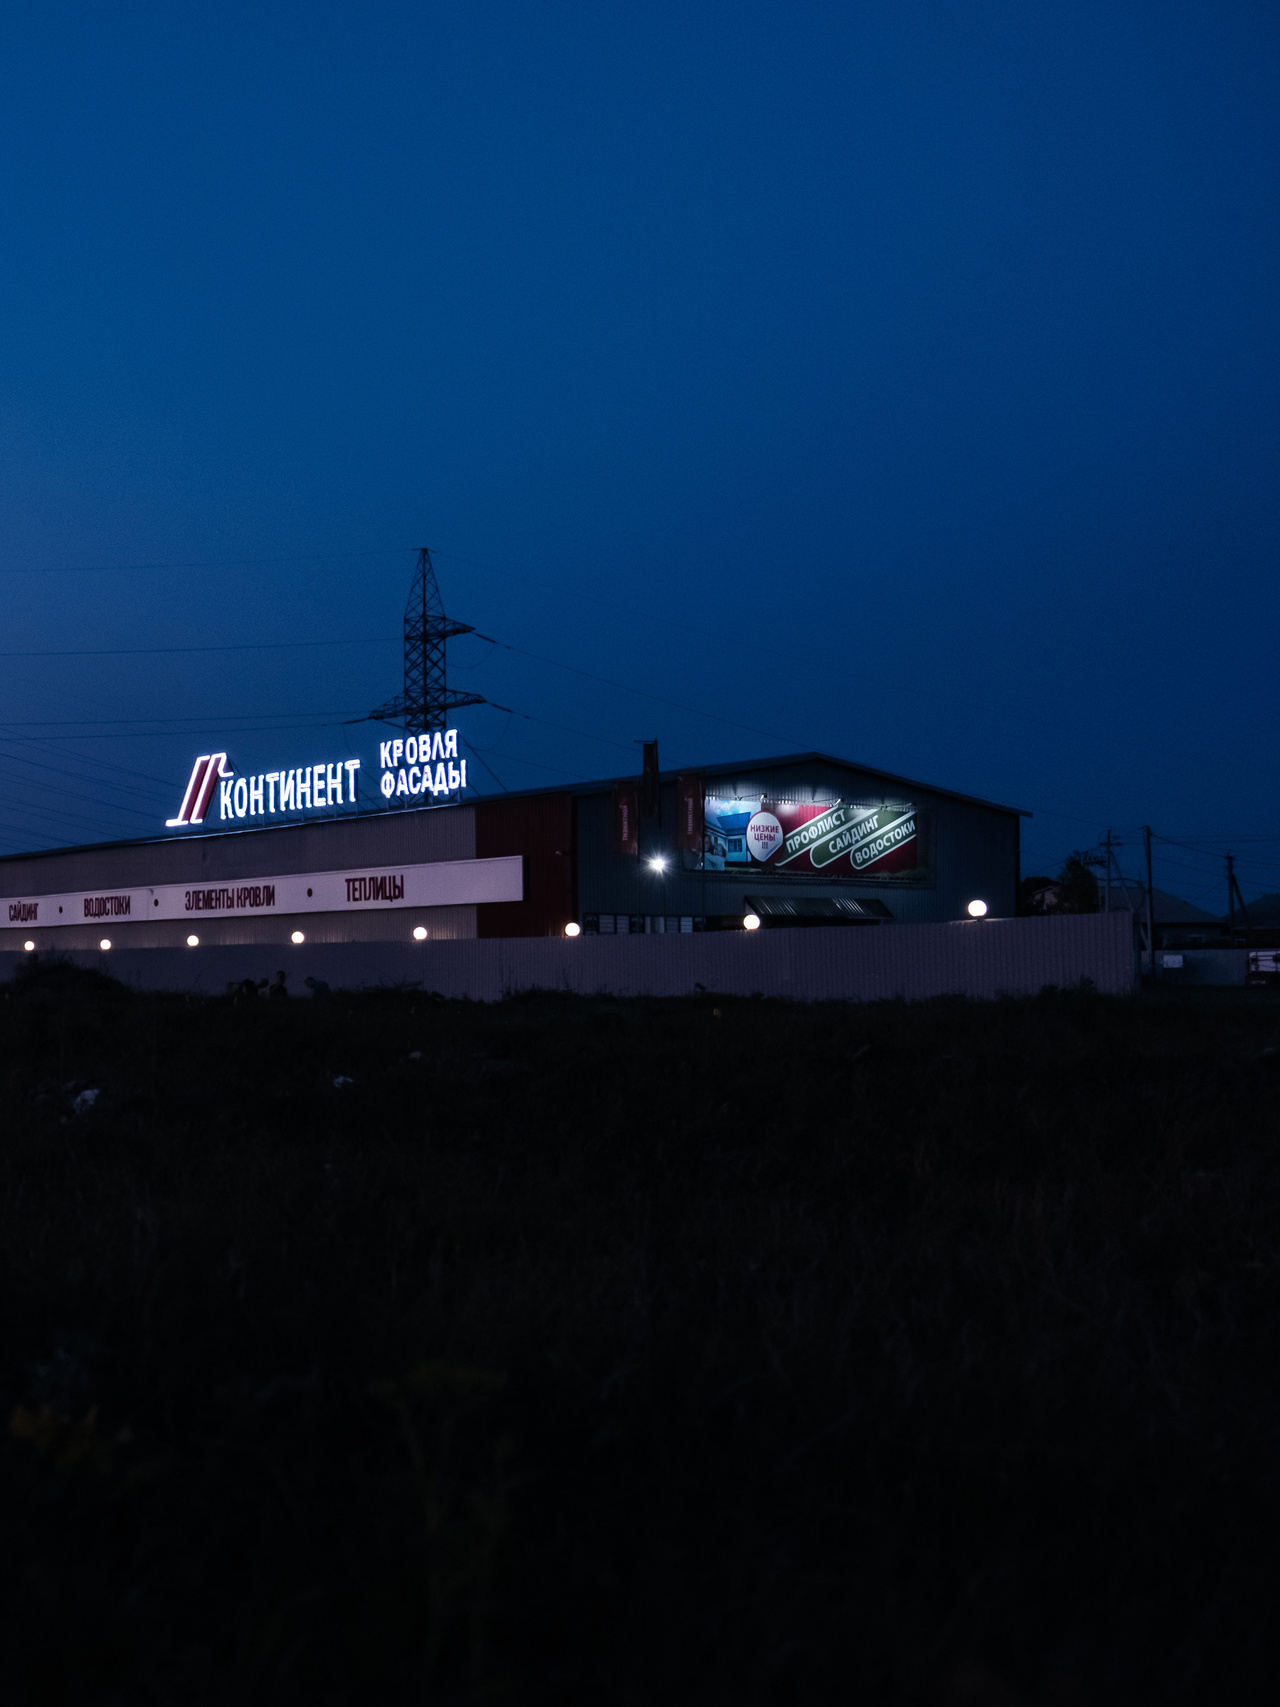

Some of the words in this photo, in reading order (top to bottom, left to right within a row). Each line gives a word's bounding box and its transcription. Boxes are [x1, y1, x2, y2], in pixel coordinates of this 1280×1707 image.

[379, 729, 458, 768] КРОВЛЯ
[220, 759, 361, 820] КОНТИНЕНТ
[380, 759, 467, 798] ФАСАДЫ
[750, 824, 779, 833] НИЗКИЕ
[754, 833, 775, 842] ЦЕНЫ
[786, 809, 846, 853] ПРОФЛИСТ
[828, 814, 879, 854] САЙДИНГ
[854, 819, 916, 864] ВОДОСТОКИ
[185, 888, 235, 910] ЭЛЕМЕНТЫ
[236, 885, 275, 908] КРОВЛИ
[345, 874, 404, 902] ТЕПЛИЦЫ
[8, 901, 39, 922] САЙДИНГ
[84, 895, 131, 918] ВОДОСТОКИ
